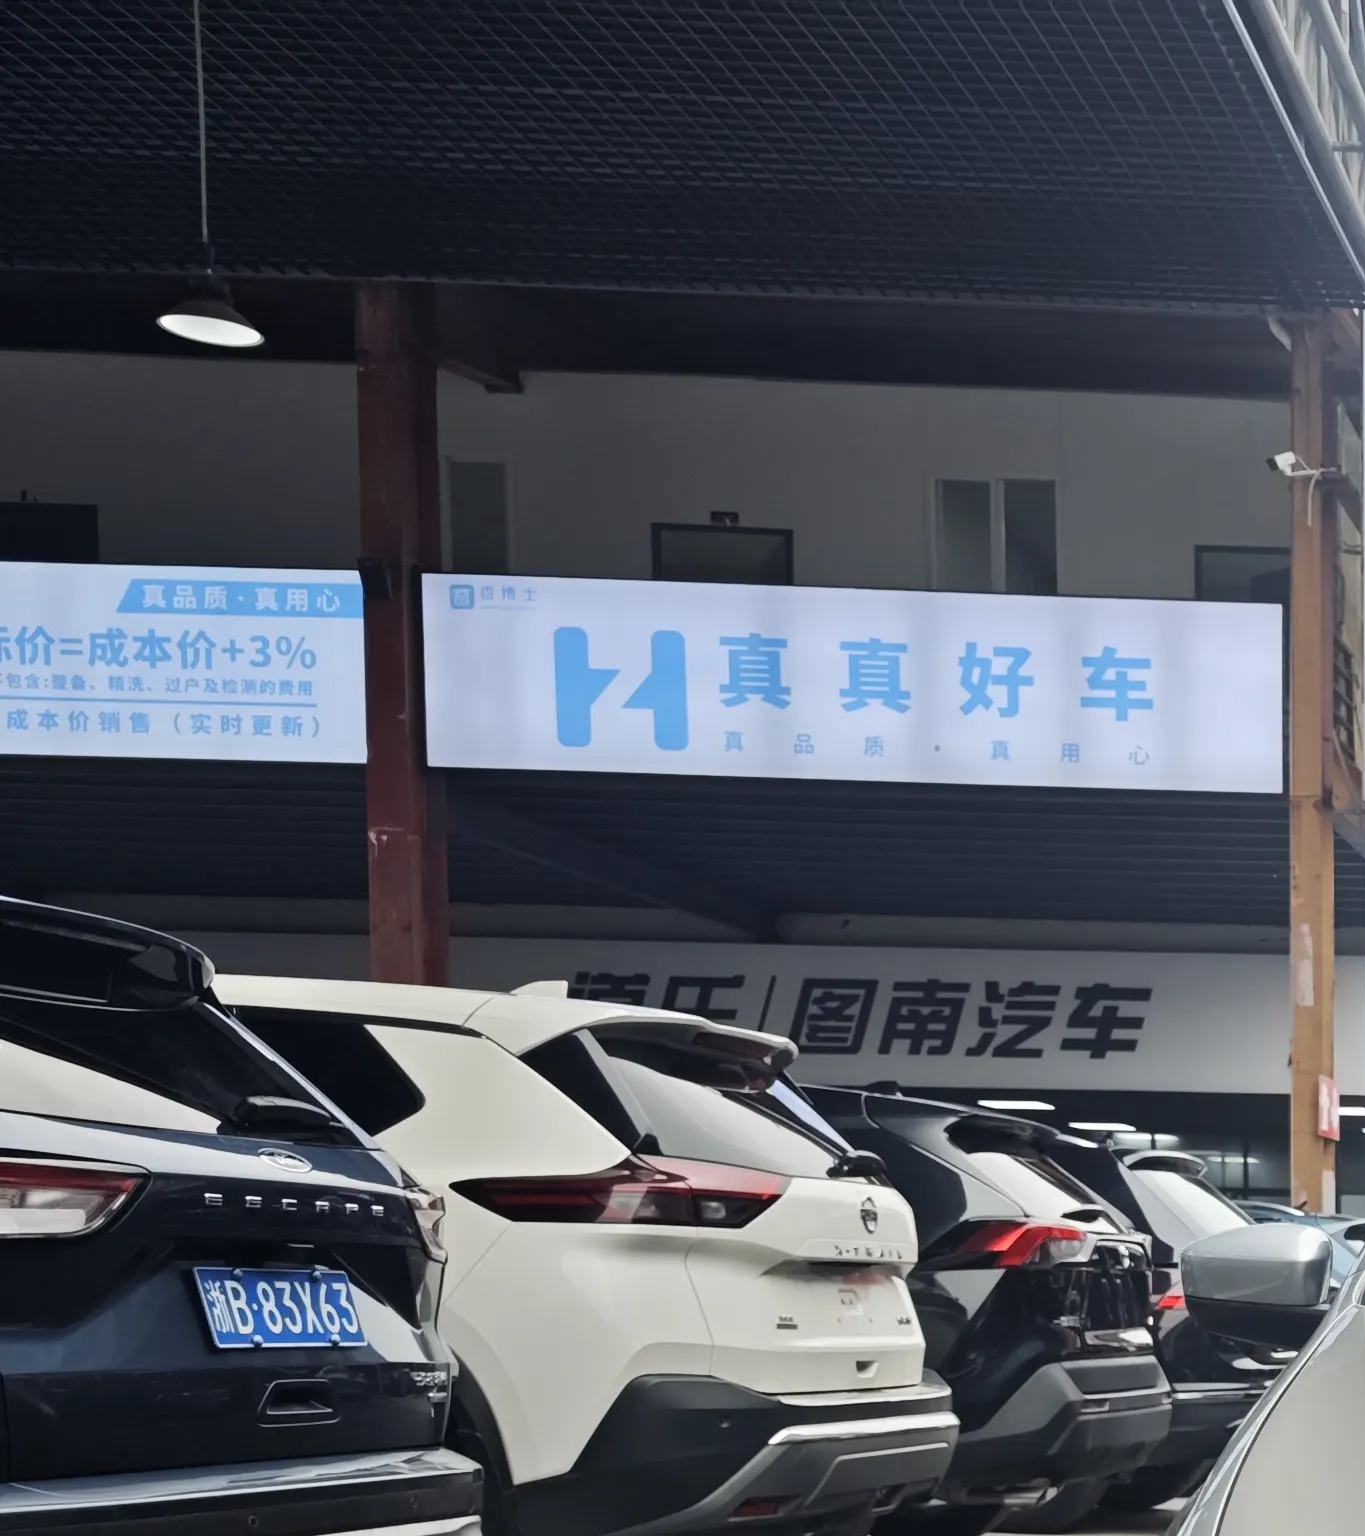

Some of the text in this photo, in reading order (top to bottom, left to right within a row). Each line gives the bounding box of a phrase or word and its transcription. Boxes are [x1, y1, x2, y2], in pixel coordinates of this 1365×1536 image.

[141, 583, 341, 613] 真品质·真用心
[718, 632, 1155, 723] 真真好车
[793, 978, 1152, 1060] 图南汽车
